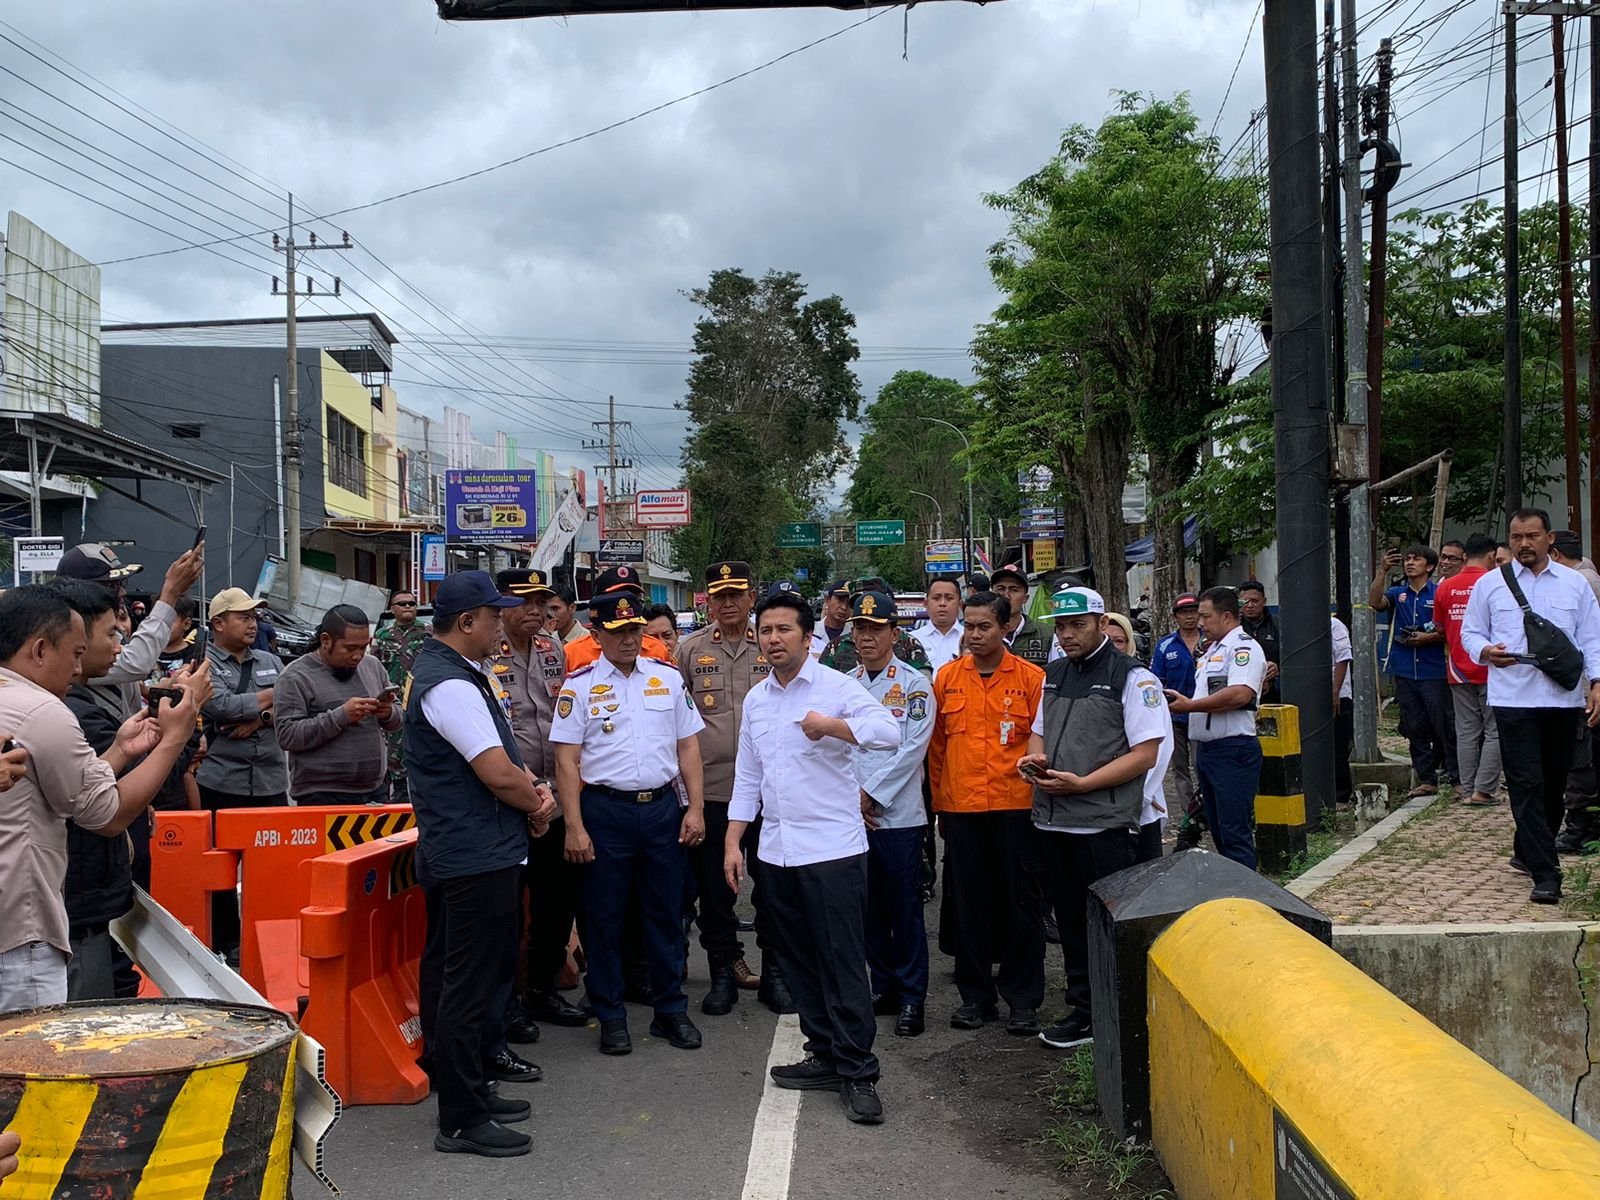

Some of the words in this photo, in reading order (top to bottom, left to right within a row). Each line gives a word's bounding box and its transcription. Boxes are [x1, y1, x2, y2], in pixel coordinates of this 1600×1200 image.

[517, 474, 531, 482] tour
[640, 495, 685, 503] Alfamart
[495, 512, 518, 523] 26
[290, 827, 317, 846] 2023
